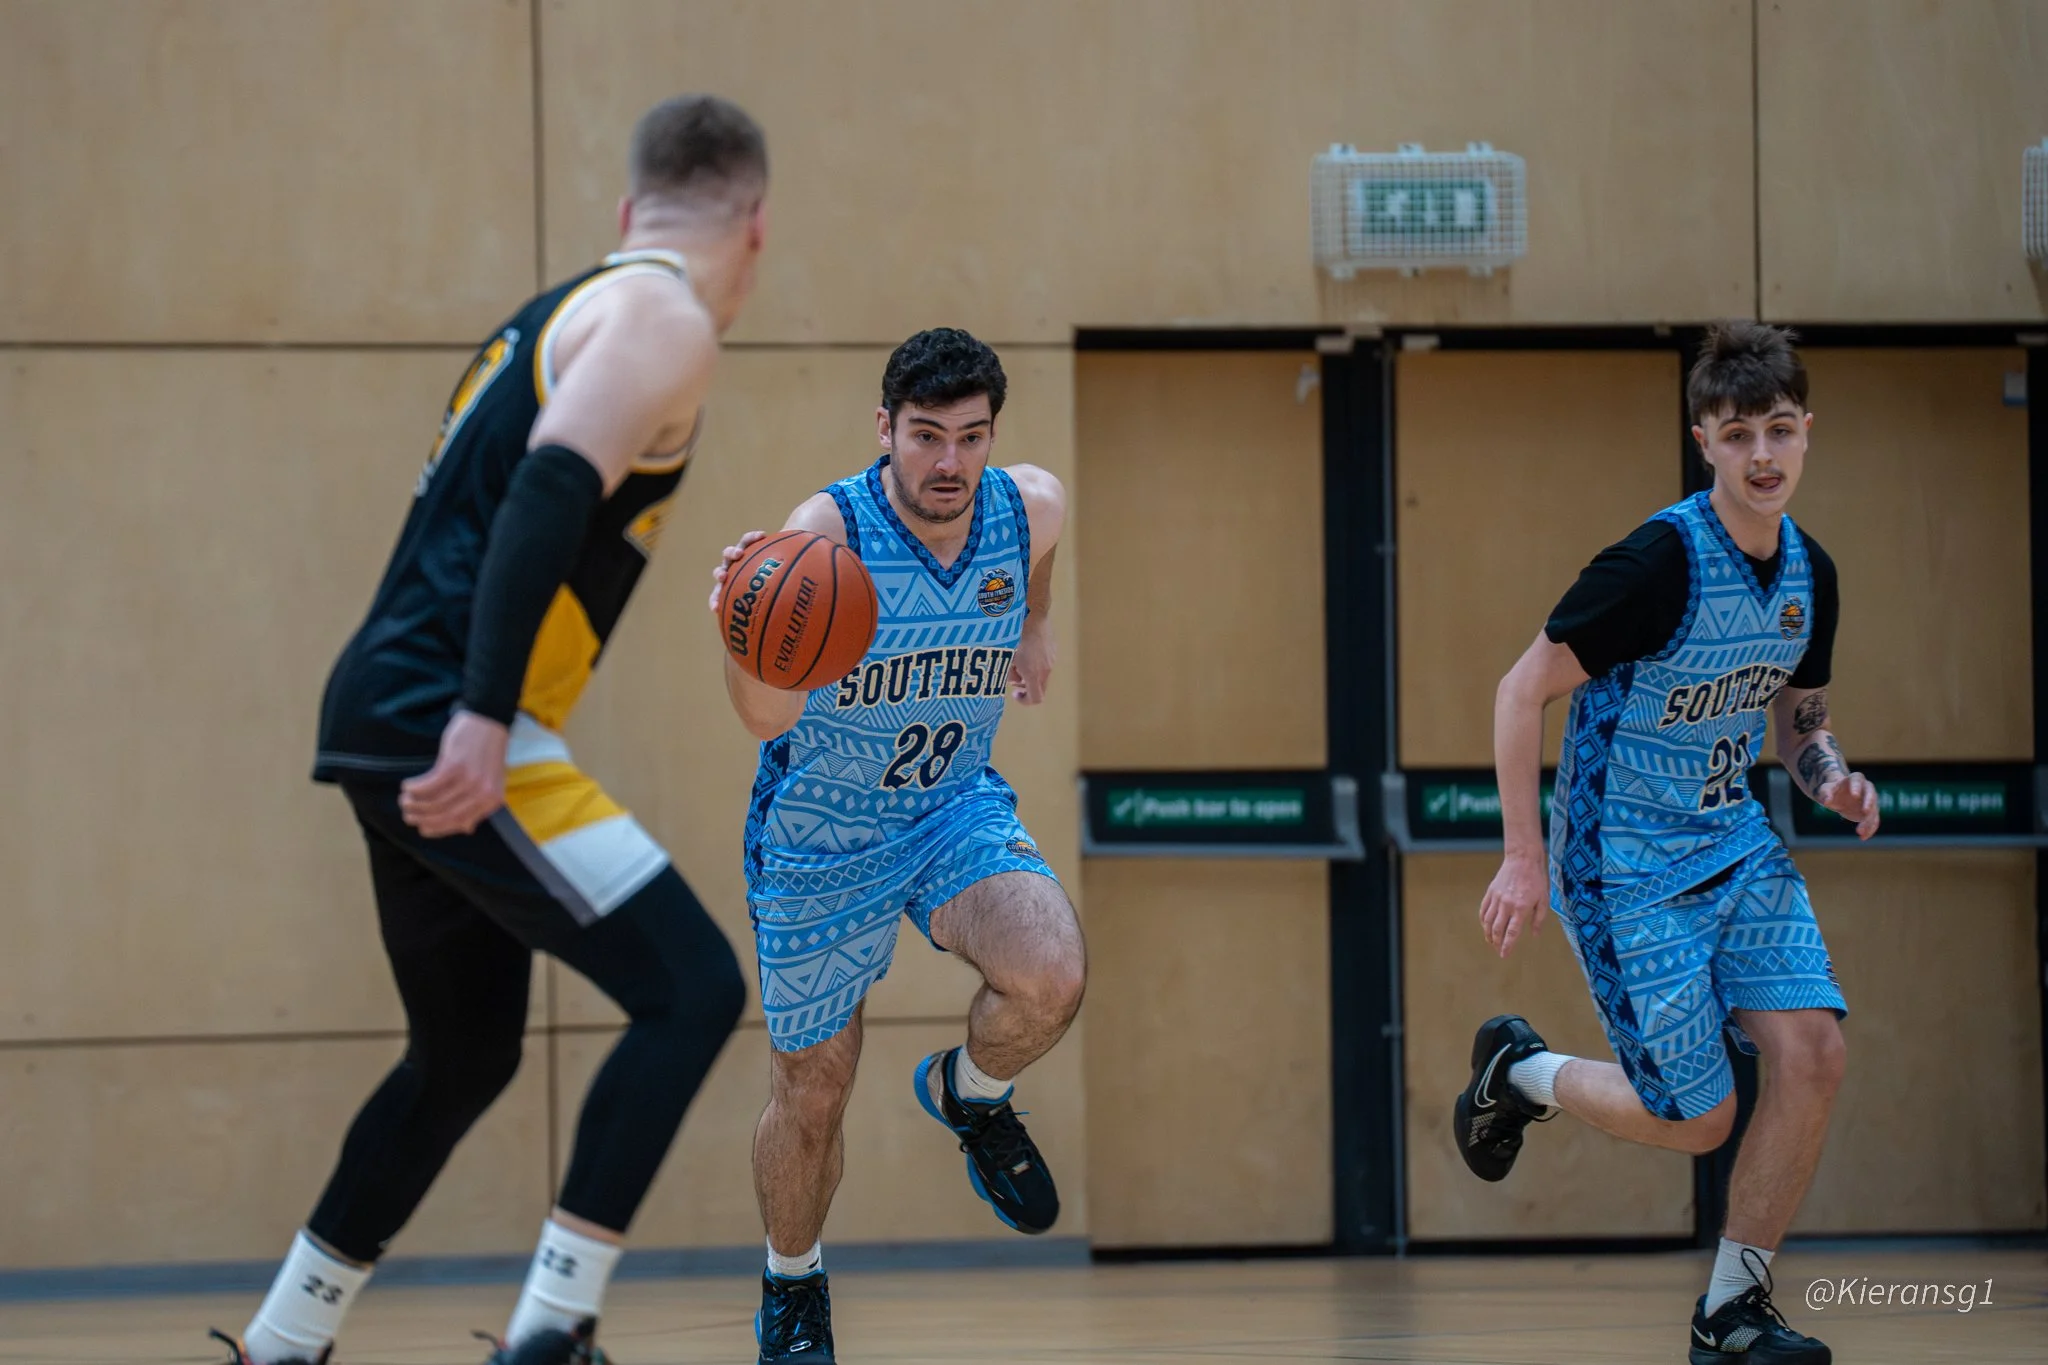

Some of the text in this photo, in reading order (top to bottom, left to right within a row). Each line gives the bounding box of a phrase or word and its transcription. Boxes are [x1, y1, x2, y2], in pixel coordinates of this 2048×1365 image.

[729, 557, 784, 657] Wilson
[774, 575, 818, 672] EVOLUTION
[880, 719, 967, 793] 28
[1230, 797, 1250, 818] to
[1252, 800, 1302, 823] open
[1898, 789, 1929, 810] bar
[1934, 788, 1953, 810] to
[1958, 792, 2003, 814] open
